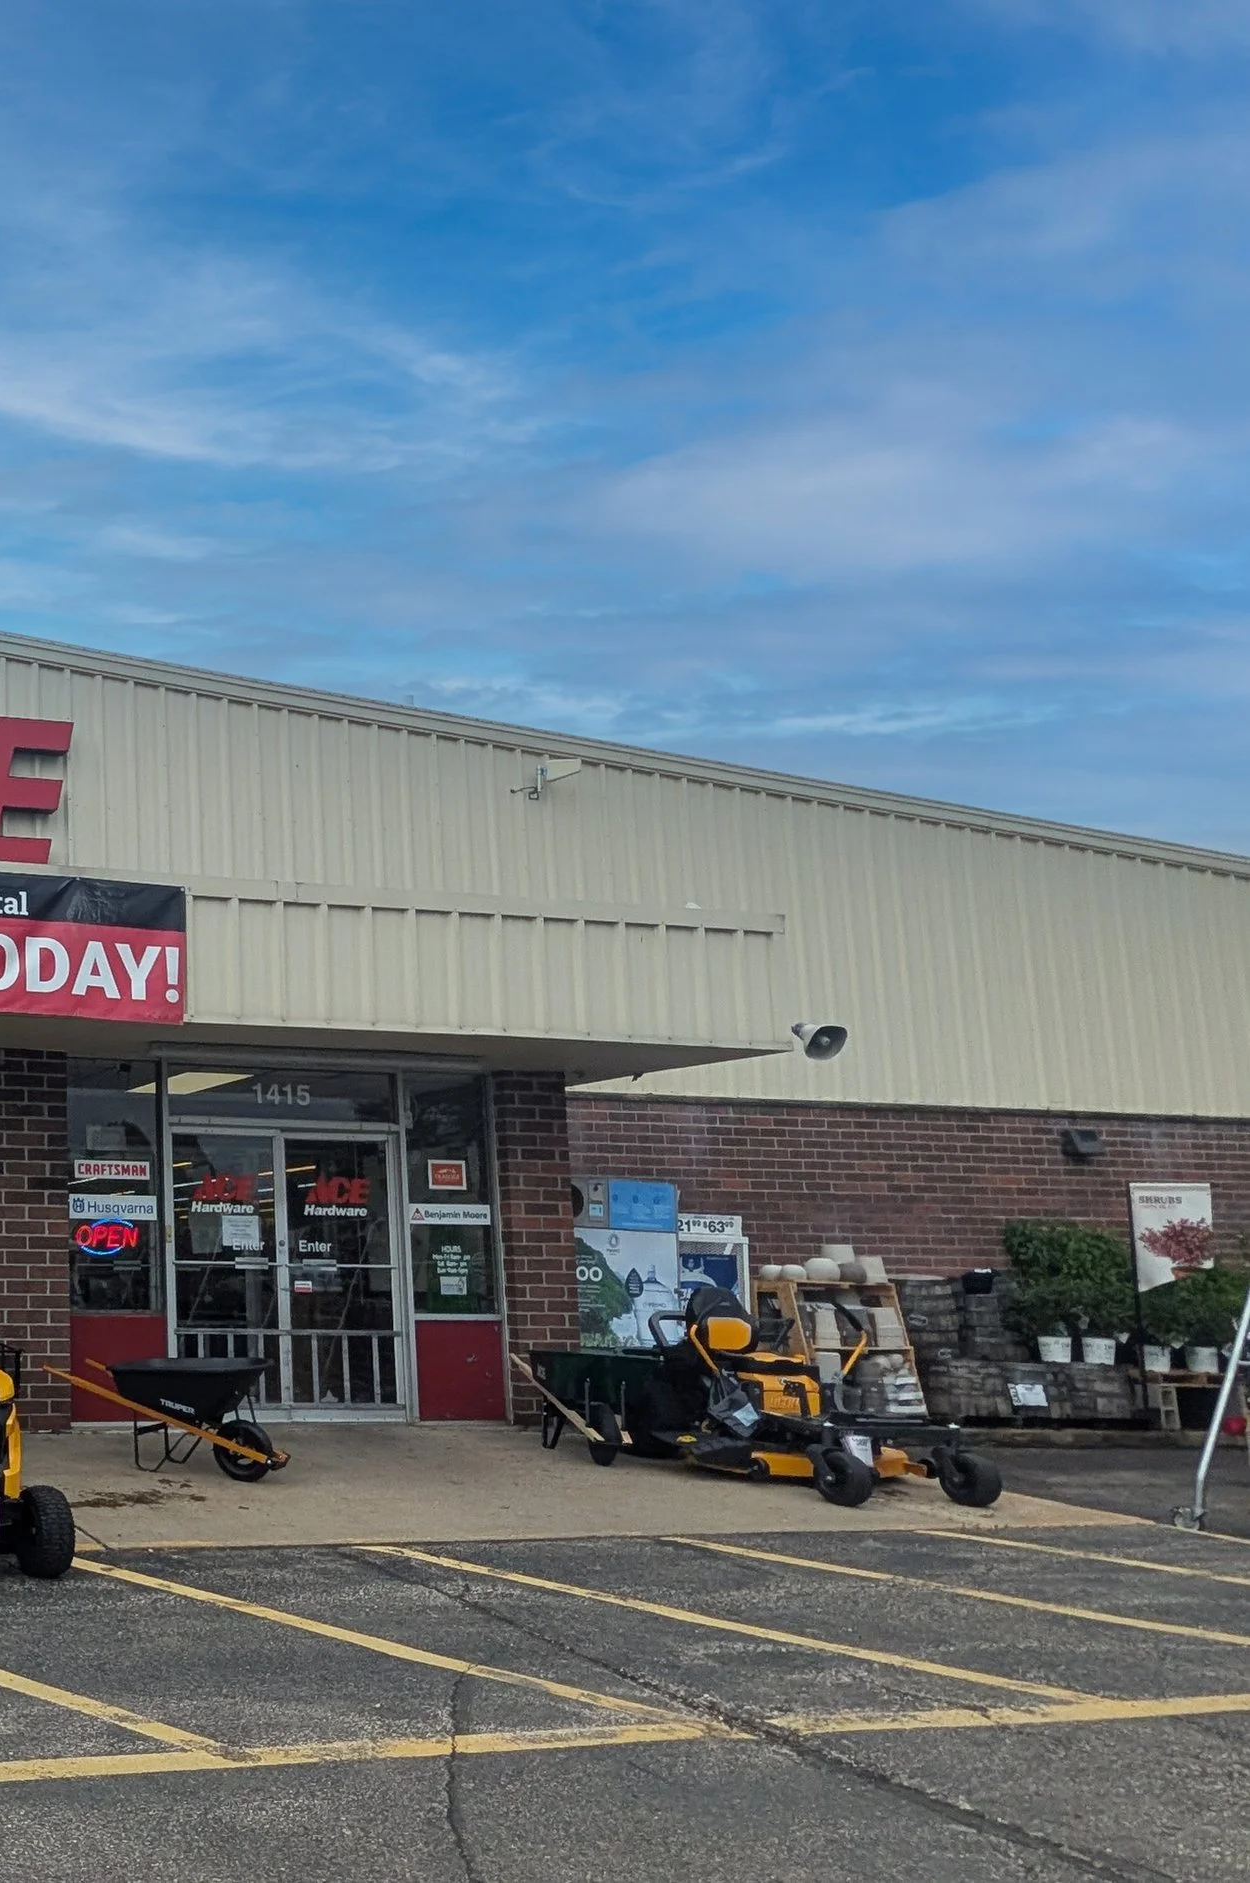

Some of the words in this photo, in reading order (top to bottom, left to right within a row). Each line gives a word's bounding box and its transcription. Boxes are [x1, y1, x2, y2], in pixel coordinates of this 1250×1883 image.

[251, 1082, 311, 1106] 1415
[77, 1163, 147, 1177] CRAFTSMAN
[191, 1172, 255, 1203] ACE
[305, 1174, 371, 1205] ACE
[87, 1201, 154, 1216] Husqvarna
[191, 1201, 255, 1214] Hardware
[304, 1204, 368, 1217] Hardware
[424, 1210, 461, 1221] Benjamin
[463, 1211, 488, 1220] Moore
[75, 1224, 140, 1249] OPEN
[232, 1240, 265, 1251] Enter
[299, 1240, 332, 1253] Enter
